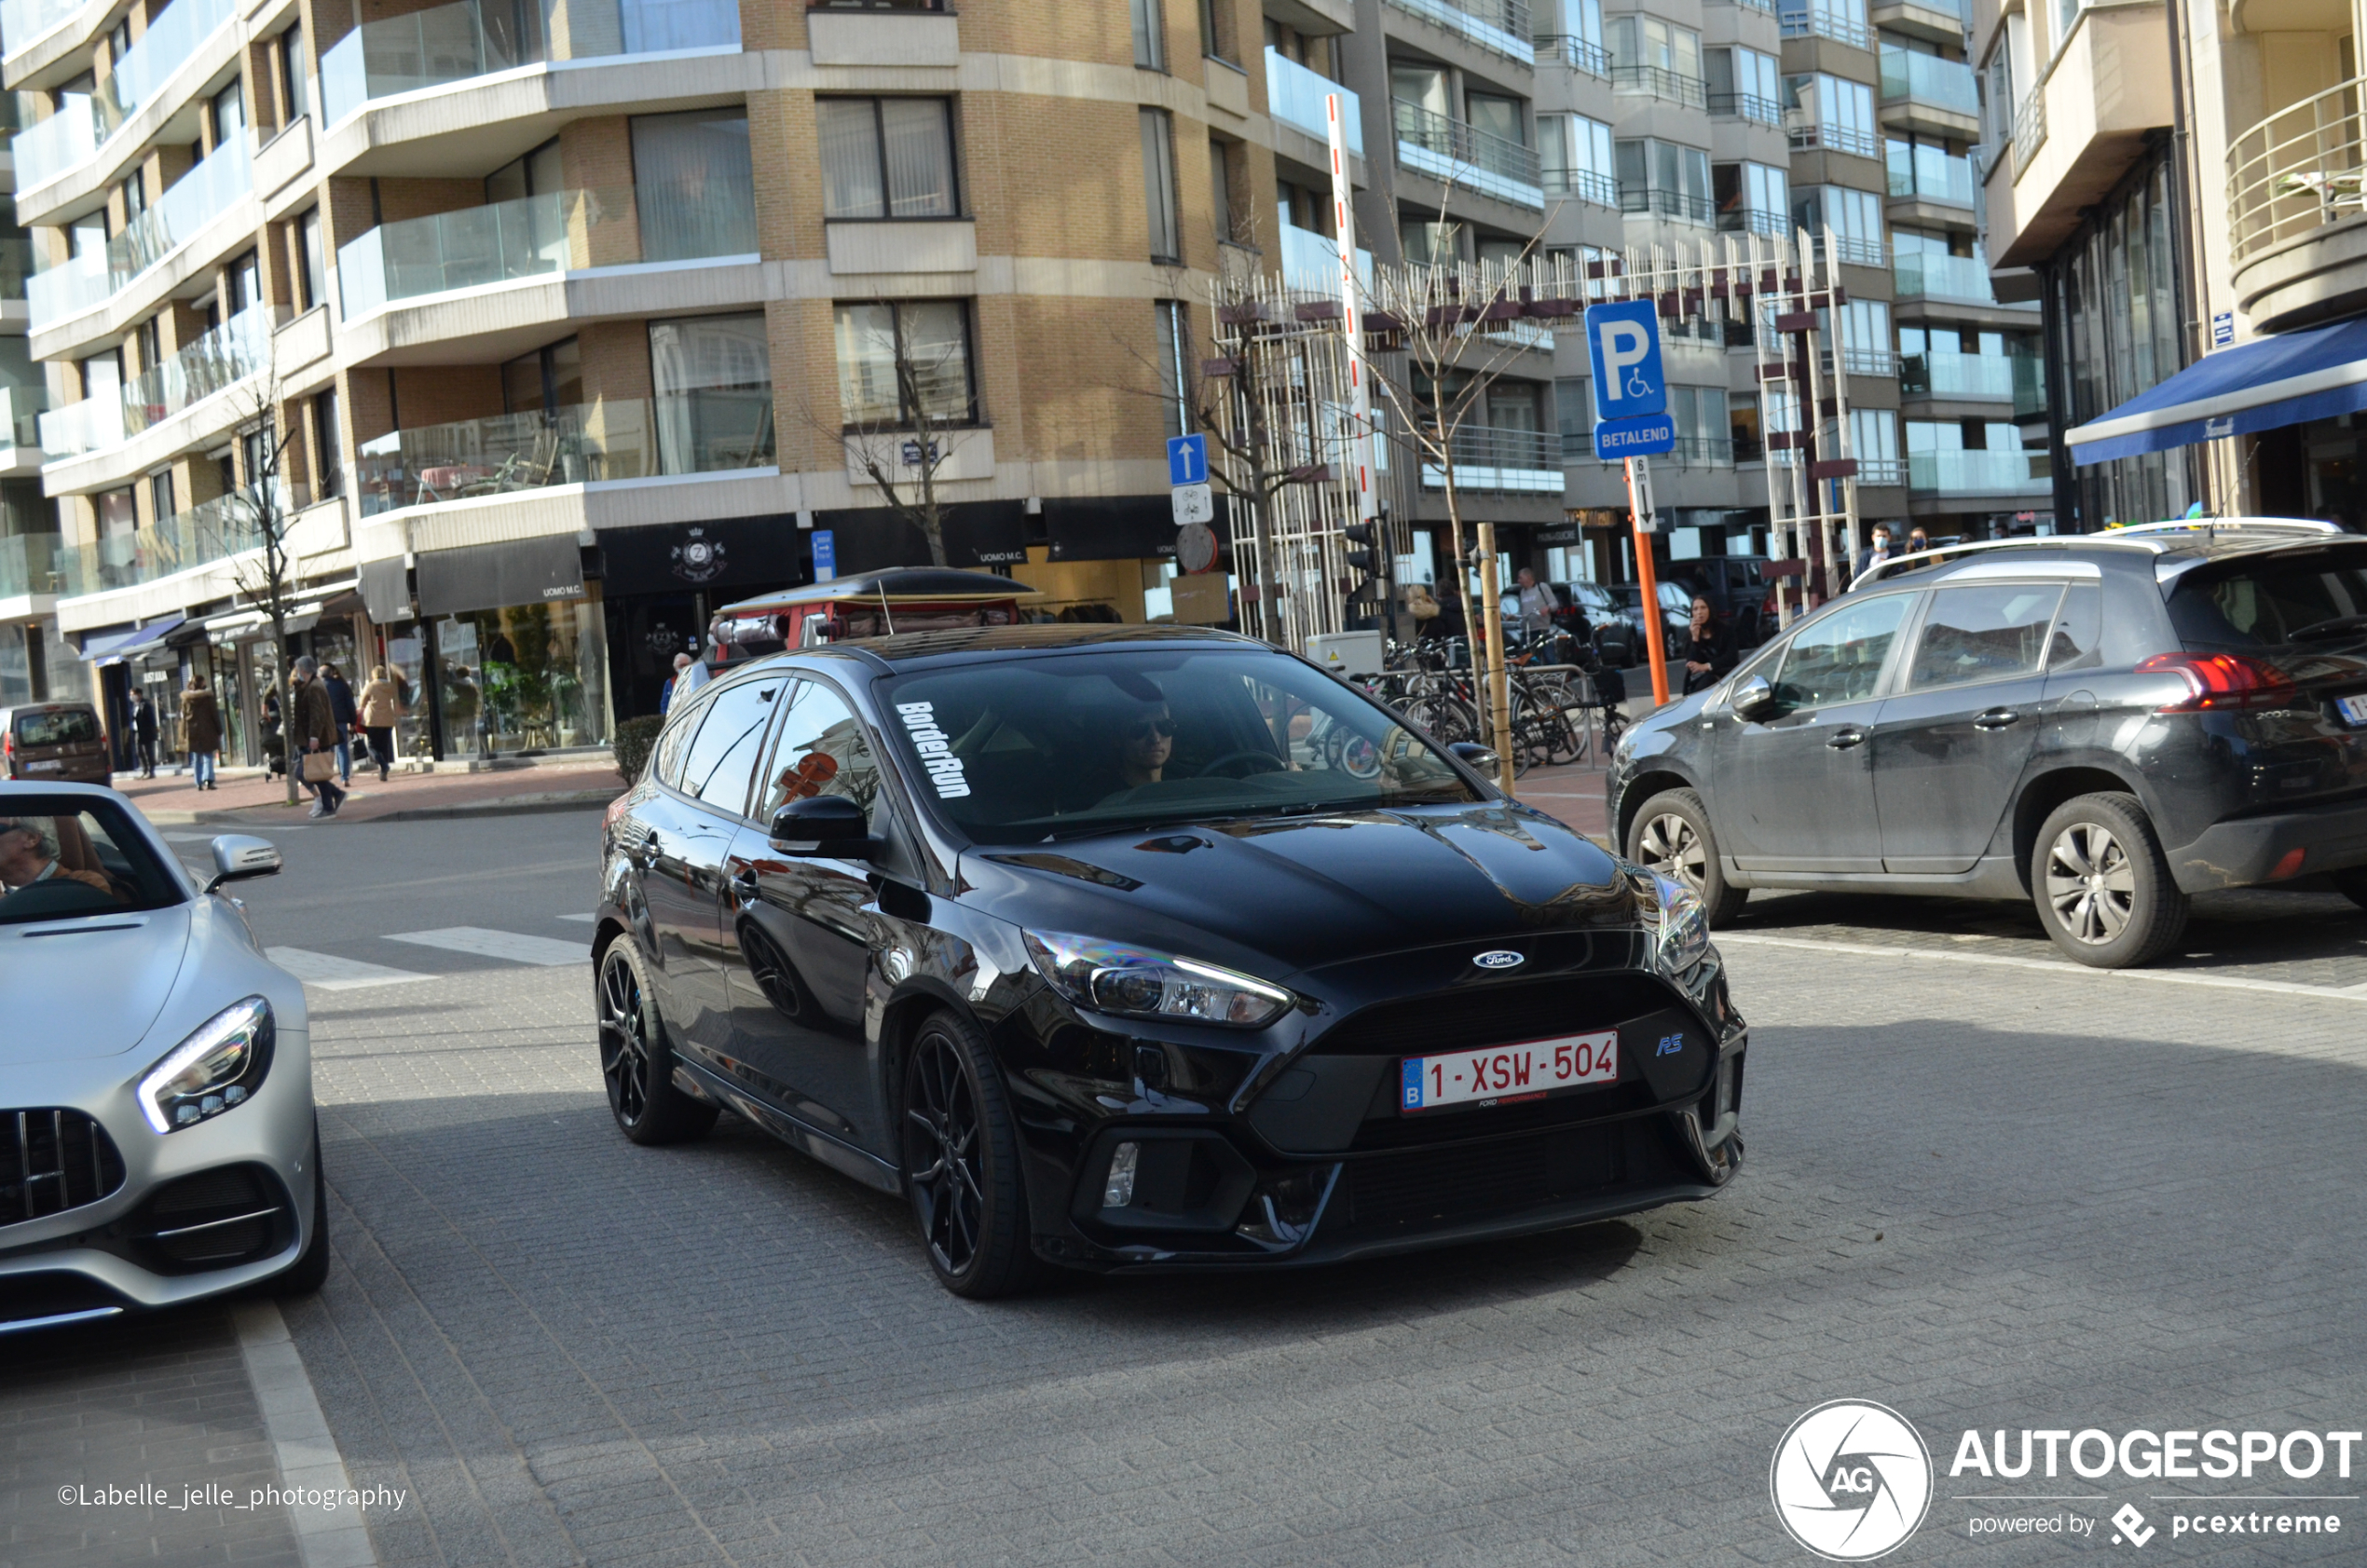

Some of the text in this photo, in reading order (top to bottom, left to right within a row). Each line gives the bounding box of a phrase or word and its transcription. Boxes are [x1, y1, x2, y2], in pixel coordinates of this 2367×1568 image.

[1599, 320, 1649, 401] P
[1602, 426, 1669, 448] BETALEND
[1637, 458, 1644, 471] 6
[693, 546, 704, 559] Z
[980, 551, 1024, 562] UOMO M.C.
[543, 584, 582, 597] UOMO M.C.
[896, 701, 971, 799] BorderRun
[1486, 954, 1512, 964] Ford
[1656, 1033, 1683, 1057] RS
[1406, 1040, 1612, 1104] B 1-XSW-504
[1479, 1091, 1548, 1107] FORD PERFORMANCE
